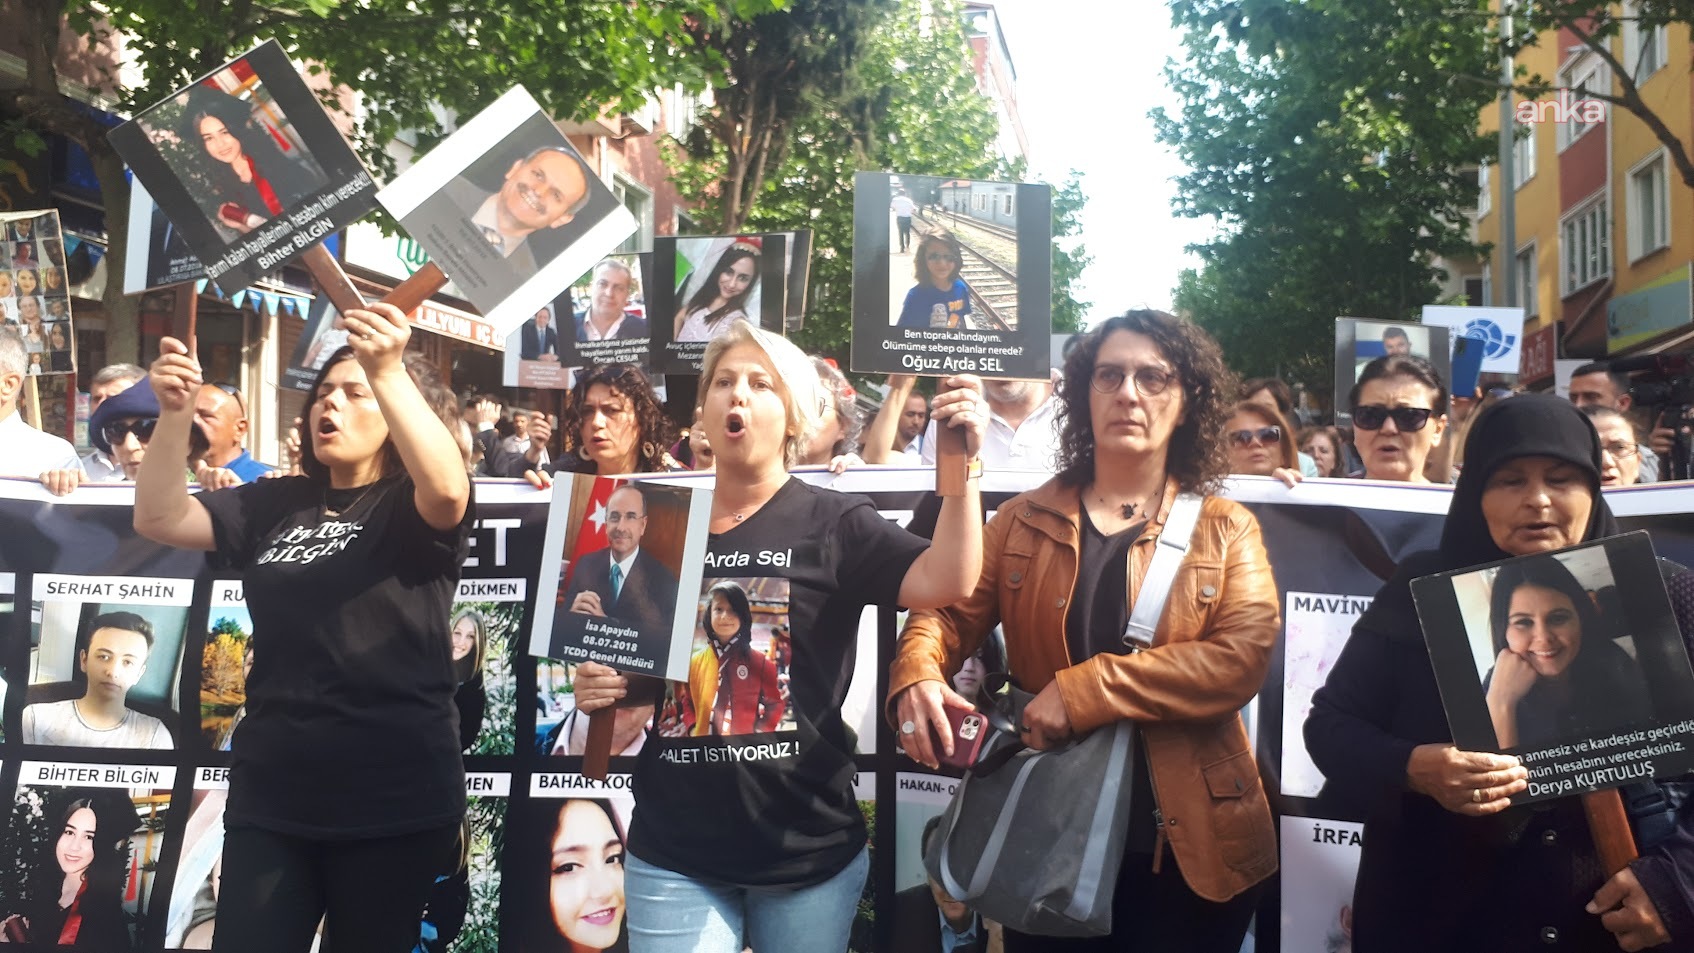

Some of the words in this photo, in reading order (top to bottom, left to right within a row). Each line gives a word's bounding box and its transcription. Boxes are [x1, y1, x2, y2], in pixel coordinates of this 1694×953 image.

[222, 247, 250, 267] kalan
[242, 220, 294, 255] hayallerimin
[318, 193, 340, 211] kim
[256, 242, 295, 270] Bihter
[293, 217, 335, 249] BİLGİN
[904, 329, 922, 339] Ben
[923, 331, 952, 342] toprak
[882, 340, 927, 352] Ölümüme
[928, 343, 955, 354] sebep
[956, 344, 987, 354] olanlar
[988, 346, 1024, 356] nerede?
[901, 354, 940, 372] Oğuz
[943, 357, 976, 371] Arda
[979, 358, 1004, 372] SEL
[704, 551, 750, 568] Arda
[756, 548, 792, 568] Sel
[47, 581, 114, 596] SERHAT
[118, 582, 174, 600] ŞAHİN
[460, 581, 517, 596] DİKMEN
[585, 619, 599, 631] İsa
[600, 624, 639, 638] Apaydın
[583, 635, 638, 652] 08.07.2018
[563, 646, 588, 657] TCDD
[590, 651, 616, 663] Genel
[617, 655, 655, 669] Müdürü
[704, 742, 791, 763] İSTİYORUZ
[1525, 743, 1571, 763] annesiz
[1572, 742, 1588, 753] ve
[1588, 729, 1645, 751] kardeşsiz
[1554, 756, 1606, 774] hesabını
[1607, 742, 1685, 764] vereceksiniz.
[38, 764, 99, 782] BİHTER
[104, 766, 159, 784] BİLGİN
[539, 775, 595, 789] BAHAR
[1528, 779, 1572, 797] Derya
[1574, 761, 1656, 788] KURTULUŞ
